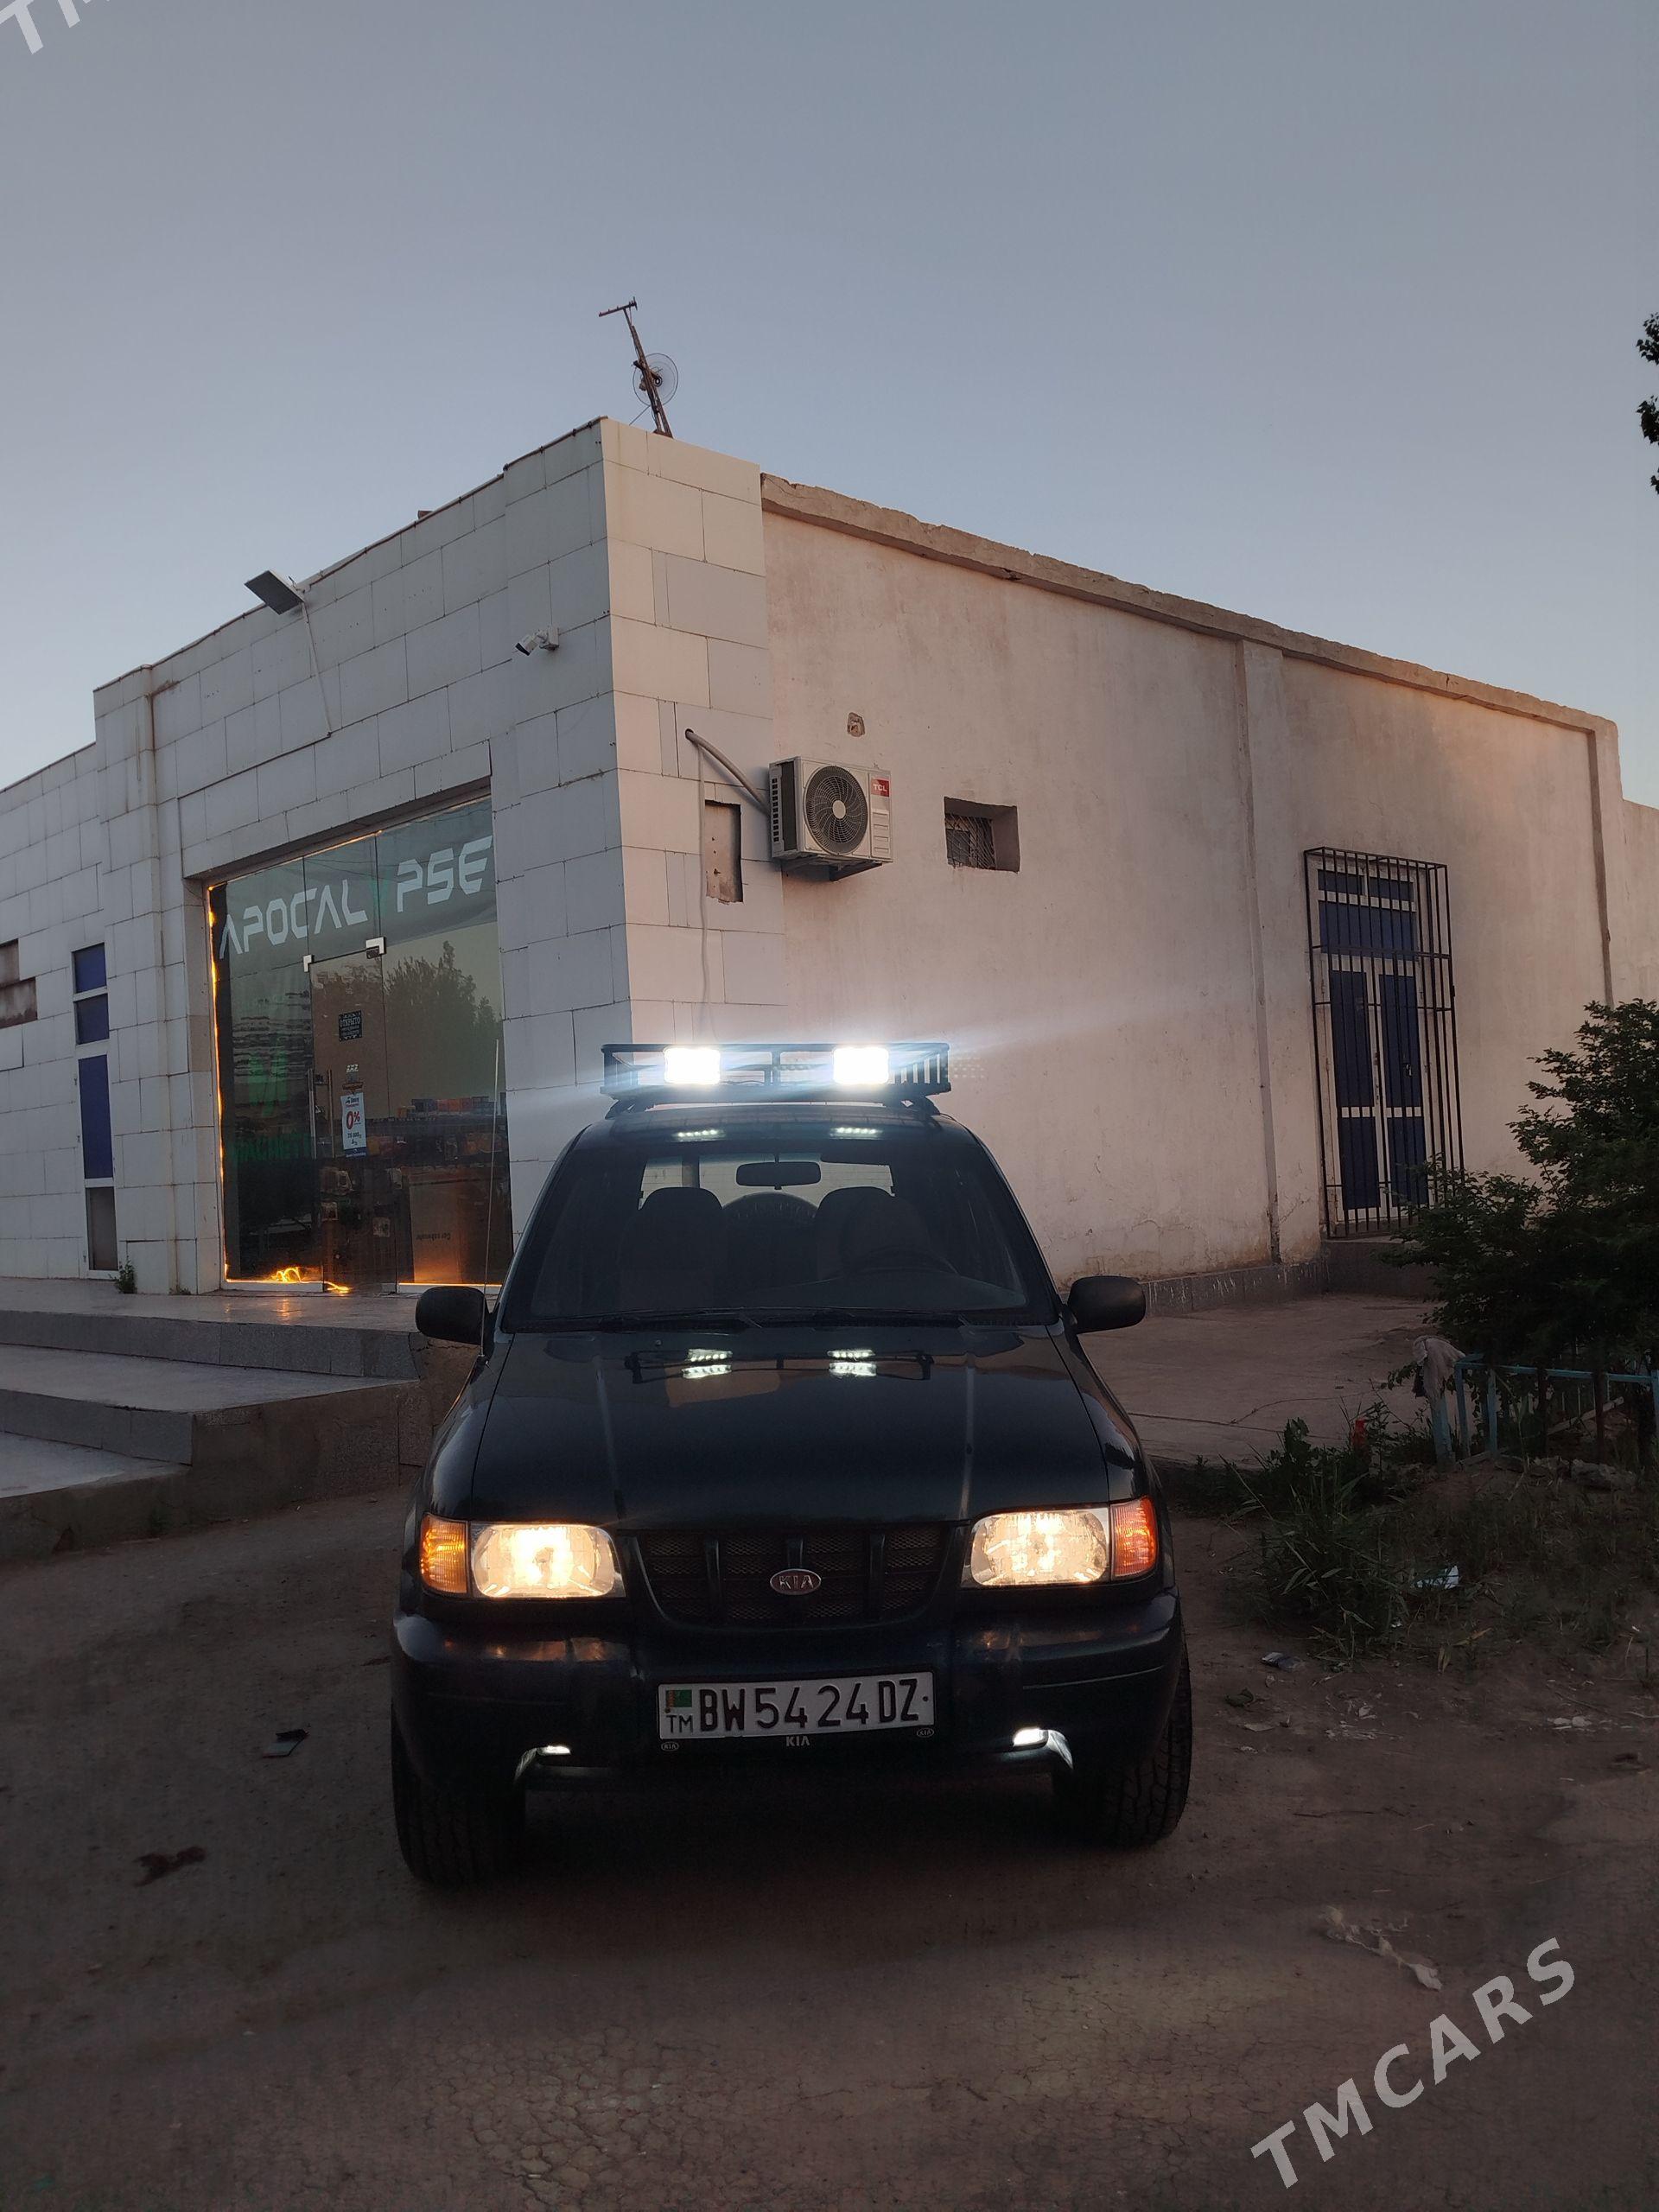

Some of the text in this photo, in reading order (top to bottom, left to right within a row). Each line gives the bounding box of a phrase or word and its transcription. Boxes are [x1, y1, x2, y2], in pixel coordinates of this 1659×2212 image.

[873, 783, 887, 792] TCL
[779, 1574, 814, 1590] KIA
[665, 1714, 694, 1733] TM
[786, 1735, 810, 1747] KIA
